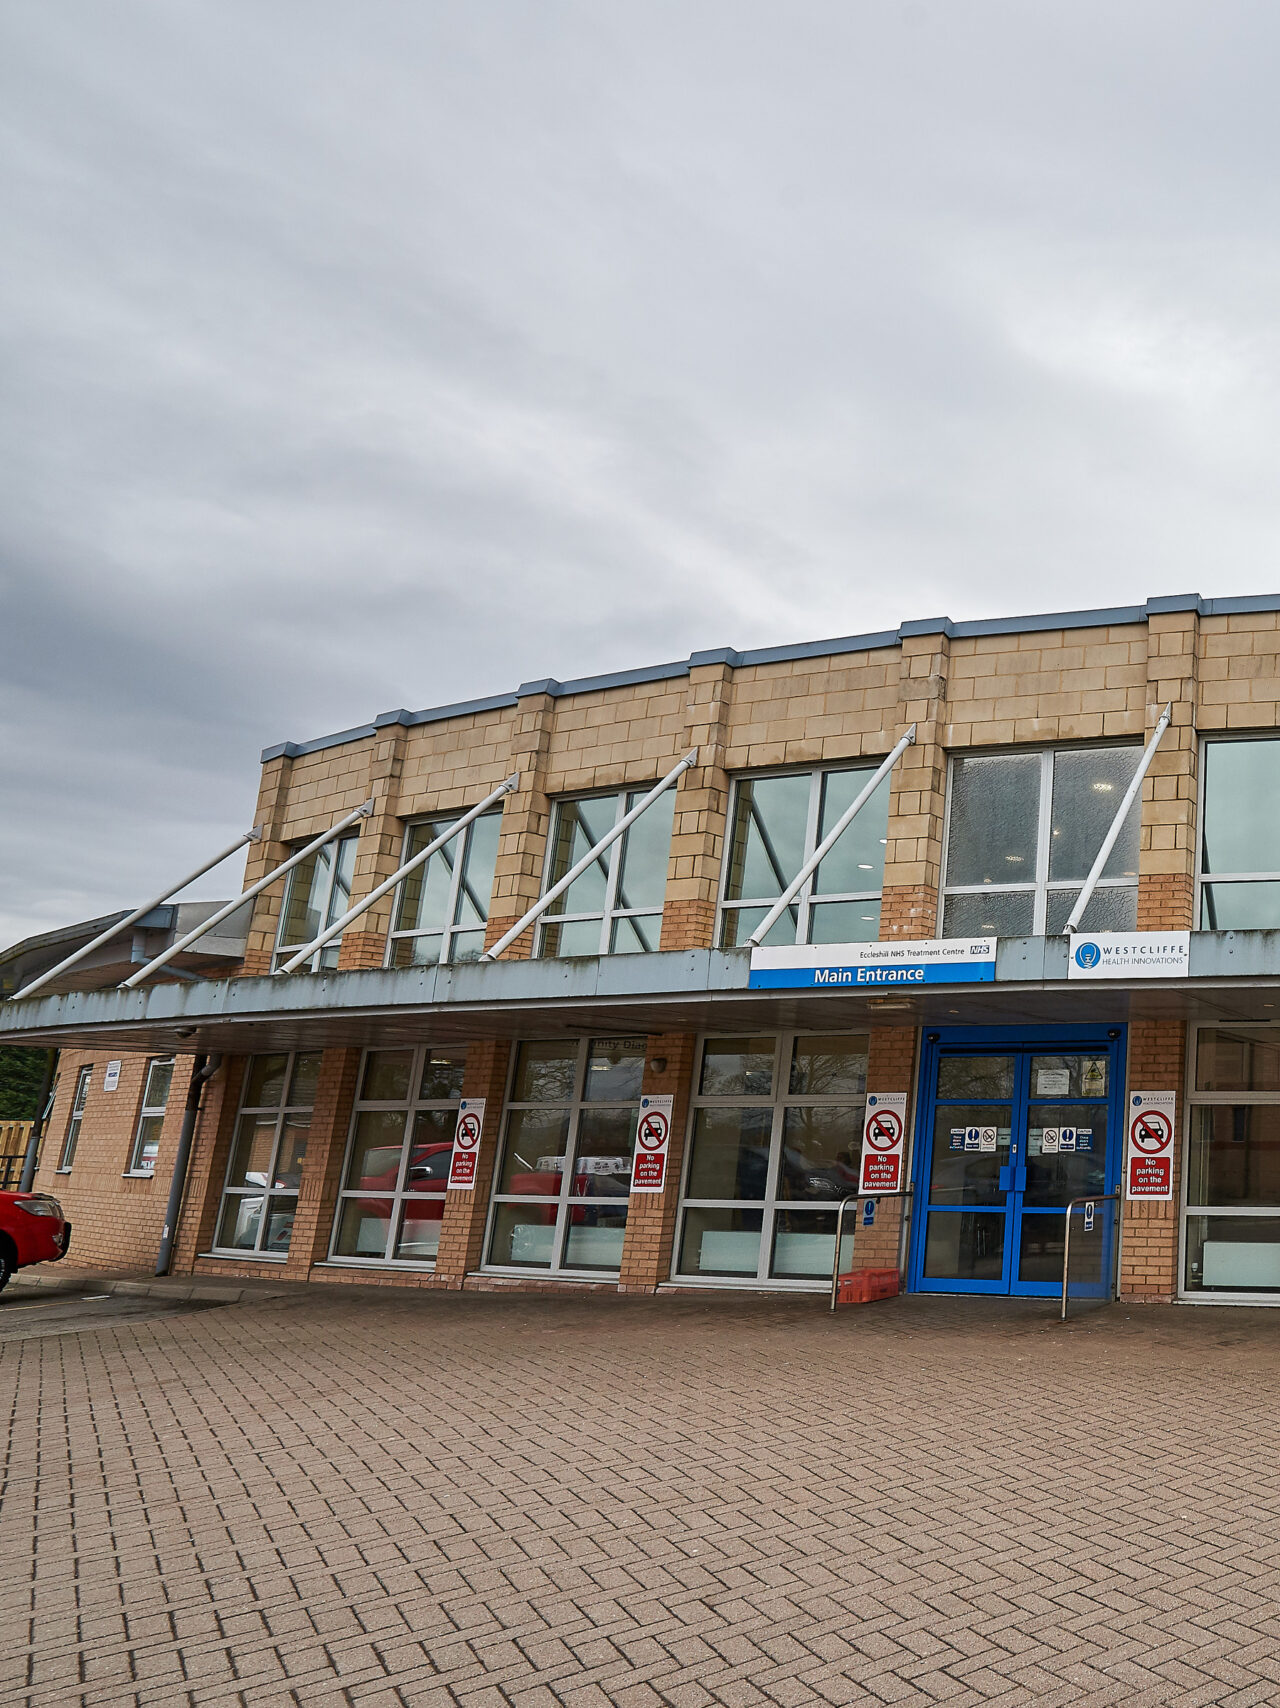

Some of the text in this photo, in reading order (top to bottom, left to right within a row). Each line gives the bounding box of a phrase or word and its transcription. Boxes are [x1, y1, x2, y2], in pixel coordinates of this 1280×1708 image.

[859, 947, 965, 959] Eccleshill NHS Treatment Centre
[971, 945, 989, 954] NHS
[1103, 945, 1184, 954] WESTCLIFFE
[1102, 956, 1183, 965] HEALTH INNOVATIONS
[814, 967, 924, 983] Main Entrance
[455, 1160, 473, 1168] parking
[639, 1162, 660, 1171] parking
[1145, 1158, 1157, 1166] No
[868, 1163, 894, 1172] parking
[1136, 1167, 1164, 1176] parking
[648, 1169, 657, 1177] the
[881, 1171, 892, 1179] the
[1149, 1175, 1162, 1183] the
[1131, 1185, 1168, 1193] pavement
